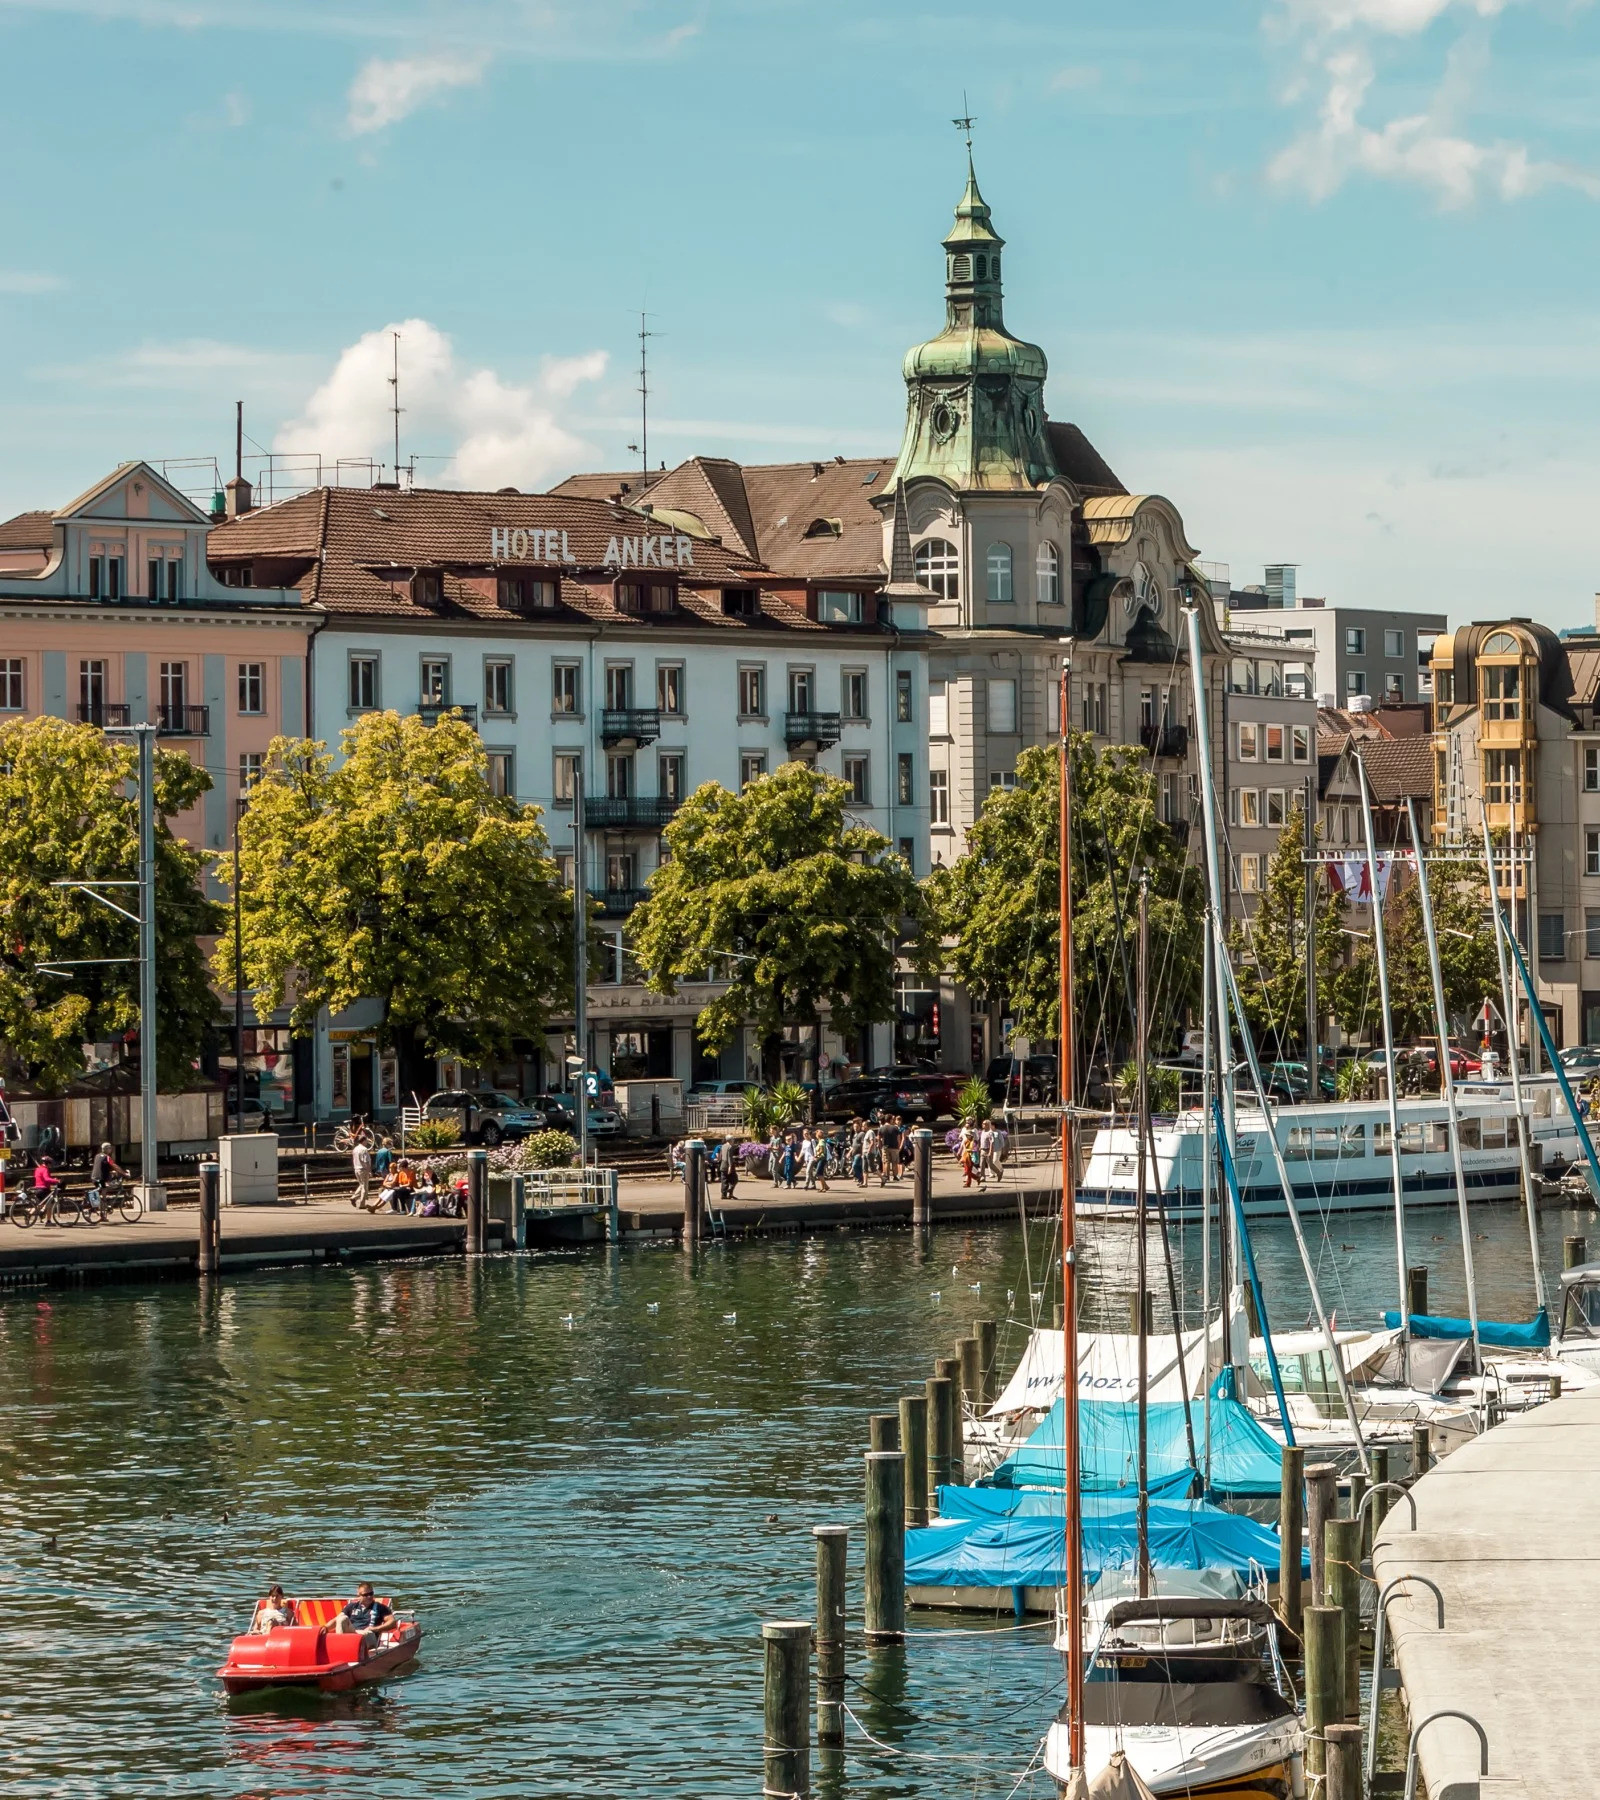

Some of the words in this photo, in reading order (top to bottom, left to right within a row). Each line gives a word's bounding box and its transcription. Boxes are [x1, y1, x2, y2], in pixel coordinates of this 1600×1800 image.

[491, 527, 576, 562] HOTEL
[603, 535, 694, 567] ANKER
[586, 1077, 597, 1094] 2
